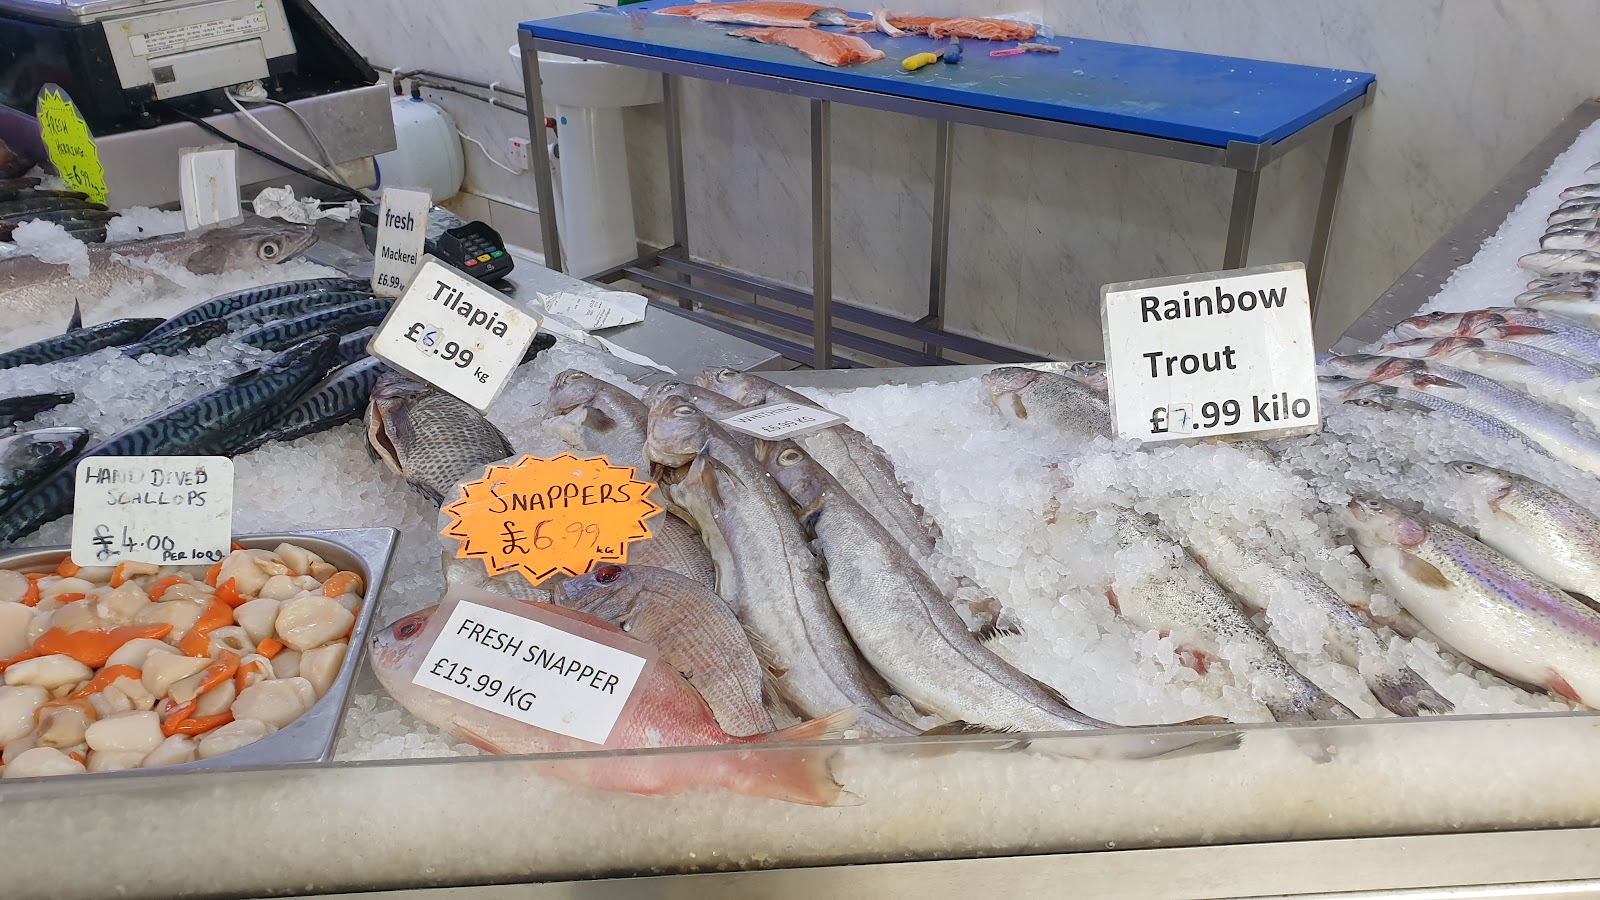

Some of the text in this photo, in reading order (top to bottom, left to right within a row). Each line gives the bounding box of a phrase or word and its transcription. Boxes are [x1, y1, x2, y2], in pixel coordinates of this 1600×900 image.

[385, 208, 414, 231] fresh
[381, 246, 418, 265] Mackerel
[377, 273, 400, 289] £6.99
[432, 280, 509, 338] Tilapia
[1140, 286, 1288, 323] Rainbow
[403, 322, 490, 384] £6.99 kg
[1142, 345, 1237, 378] Trout
[1149, 391, 1311, 434] £7.99 kilo
[85, 466, 208, 487] HAND DIVED
[107, 487, 207, 507] SCALLOPS
[488, 481, 631, 513] SNAPPERS
[91, 523, 175, 561] £4.00
[500, 519, 600, 555] £6.99
[162, 550, 188, 561] PER
[456, 618, 620, 695] FRESH SNAPPER
[429, 658, 537, 712] £15.99 KG
